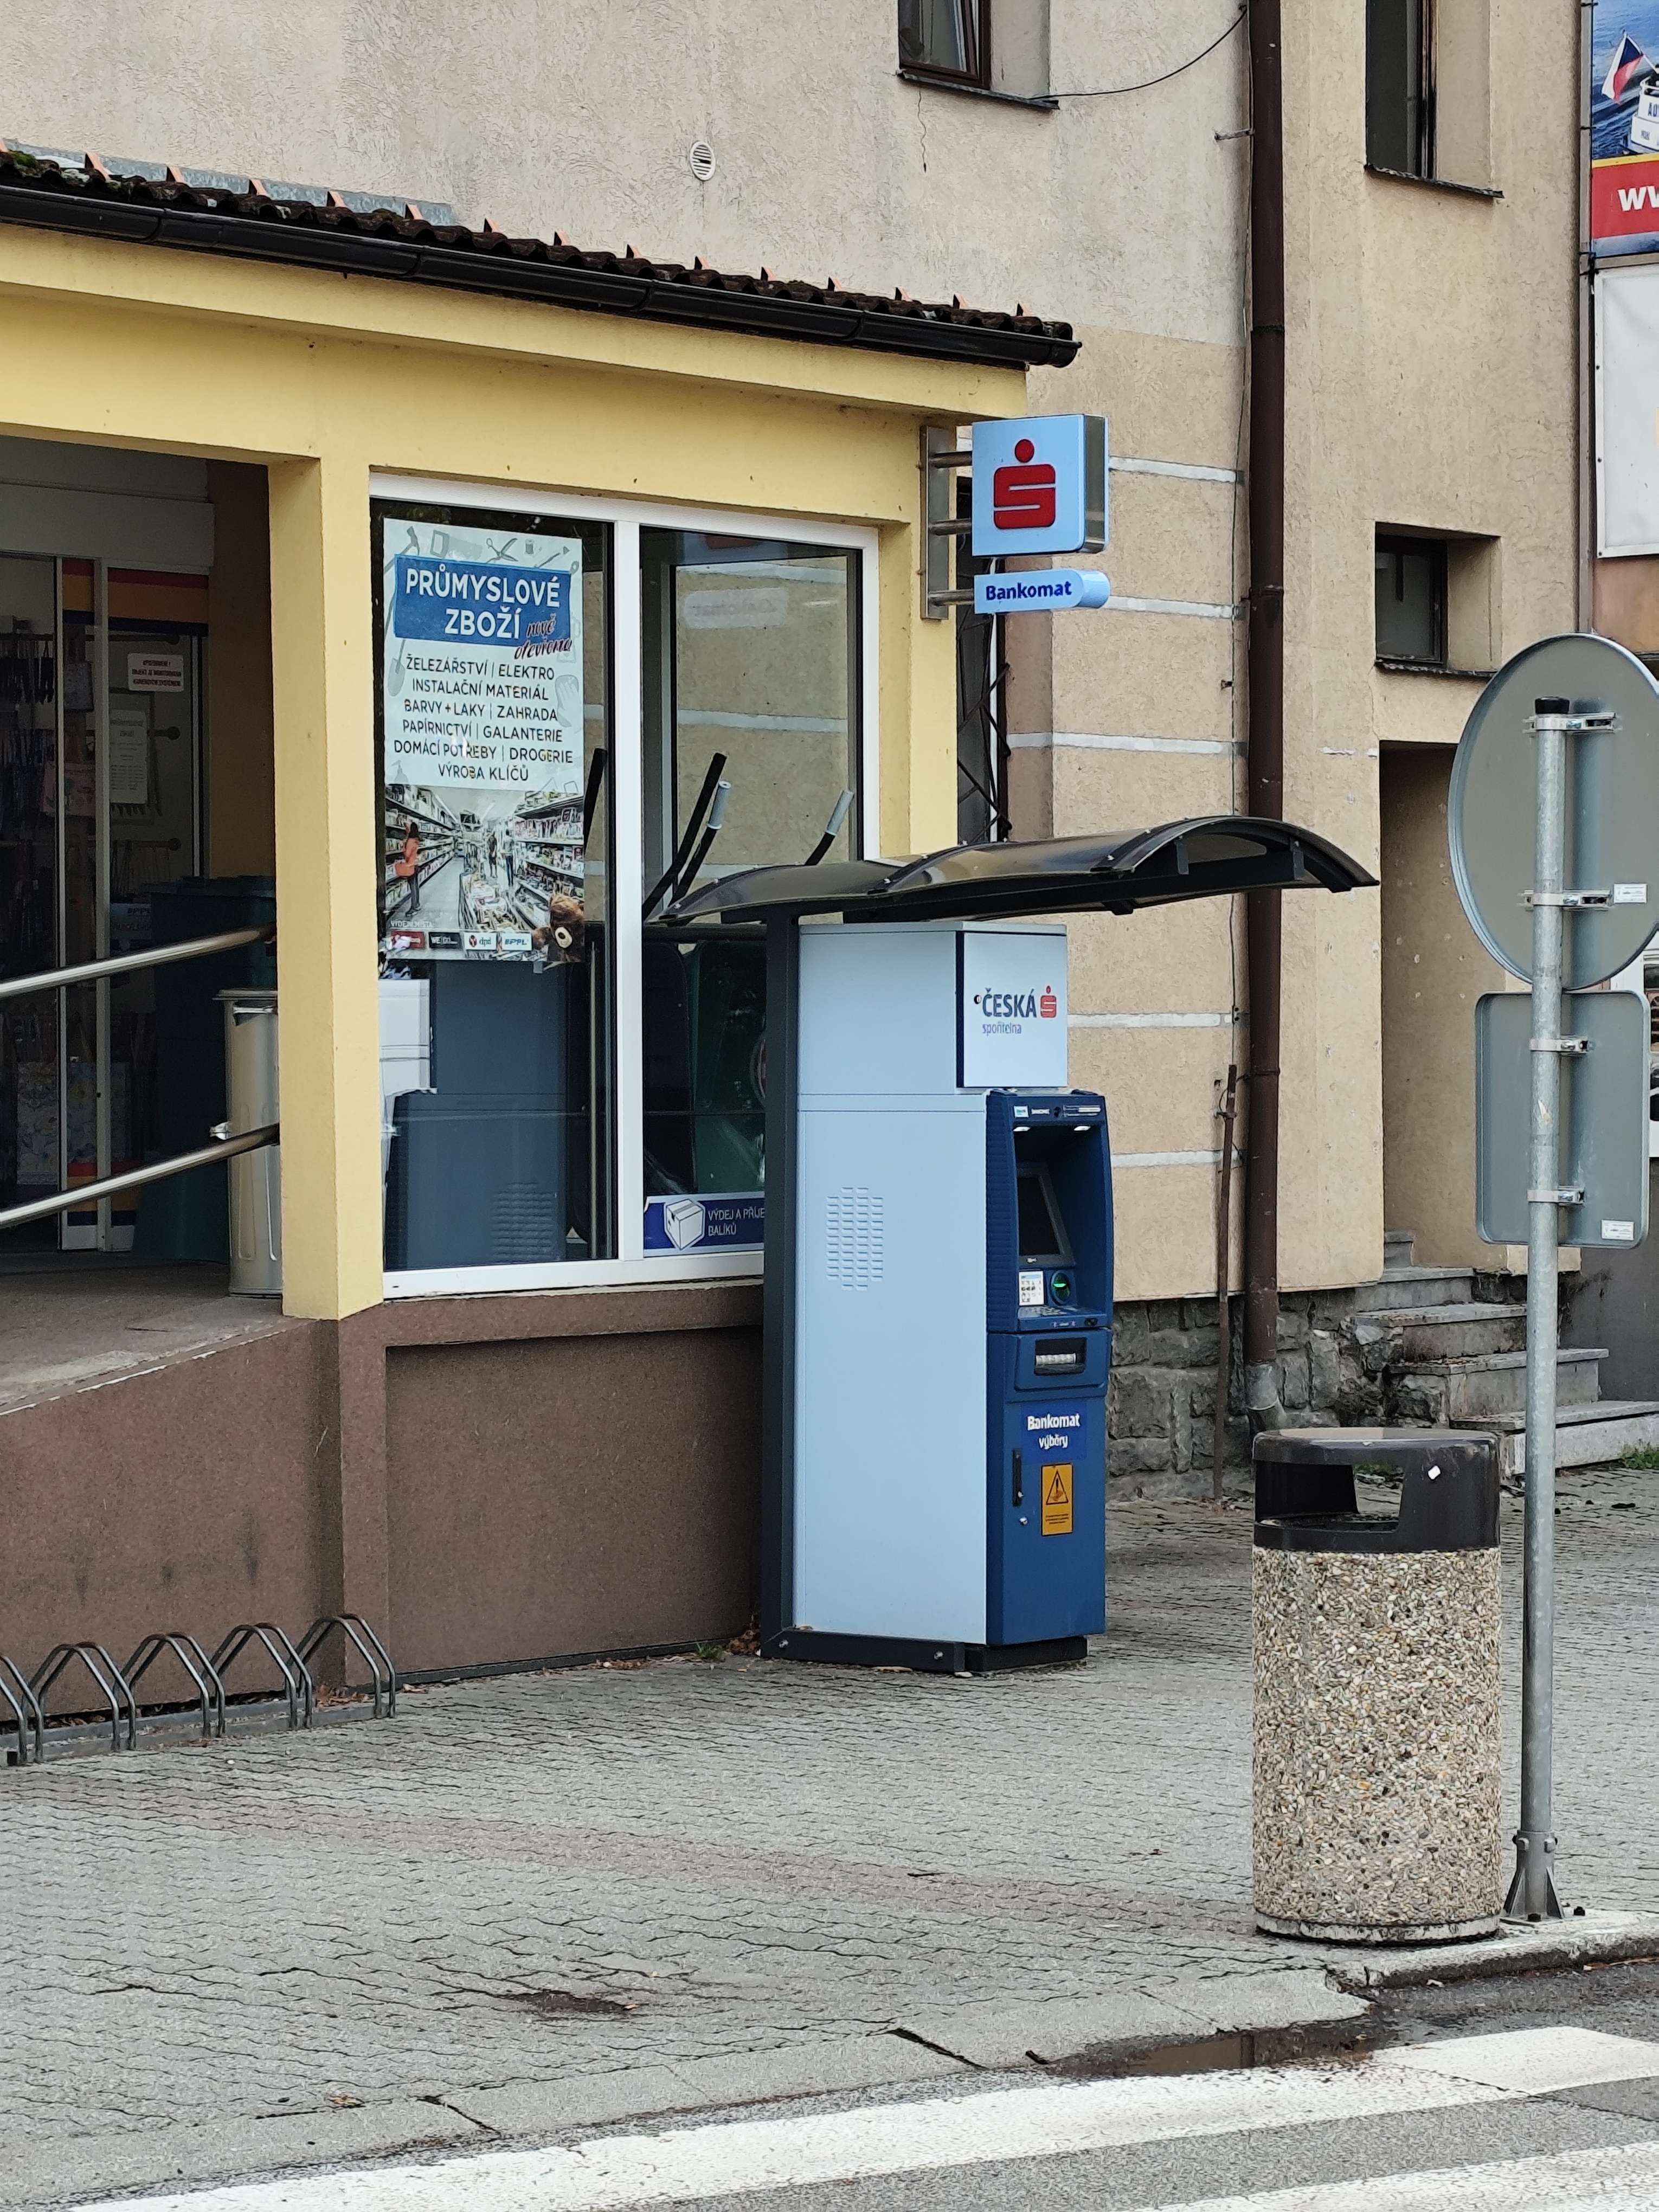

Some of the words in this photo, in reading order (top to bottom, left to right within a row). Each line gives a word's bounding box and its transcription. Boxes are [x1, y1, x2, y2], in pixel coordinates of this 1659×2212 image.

[406, 563, 560, 608] PRŮMYSLOVÉ
[986, 581, 1072, 601] Bankomat
[445, 605, 522, 639] ZBOŽÍ
[406, 653, 489, 676] ŽELEZÁŘSTVÍ
[498, 664, 555, 680] ELEKTRO
[412, 678, 483, 696] INSTALAČNÍ
[486, 683, 549, 700] MATERIÁL
[404, 698, 442, 715] BARVY
[454, 702, 485, 717] LAKY
[497, 705, 558, 722] ZAHRADA
[403, 717, 472, 738] PAPÍRNICTVÍ
[483, 725, 563, 742] GALANTERIE
[394, 737, 440, 756] DOMÁCÍ
[443, 741, 497, 760] POTŘEBY
[509, 747, 574, 763] DROGERIE
[438, 761, 485, 780] VÝROBA
[489, 764, 529, 781] KLÍČŮ
[479, 937, 492, 947] dpd
[982, 987, 1037, 1018] ČESKÁ
[982, 1021, 1022, 1037] spořitelna
[708, 1207, 734, 1221] VÝDEJ
[735, 1208, 742, 1220] A
[708, 1221, 737, 1237] BALÍKŮ
[1027, 1413, 1081, 1431] Bankomat
[1038, 1433, 1069, 1450] výběry
